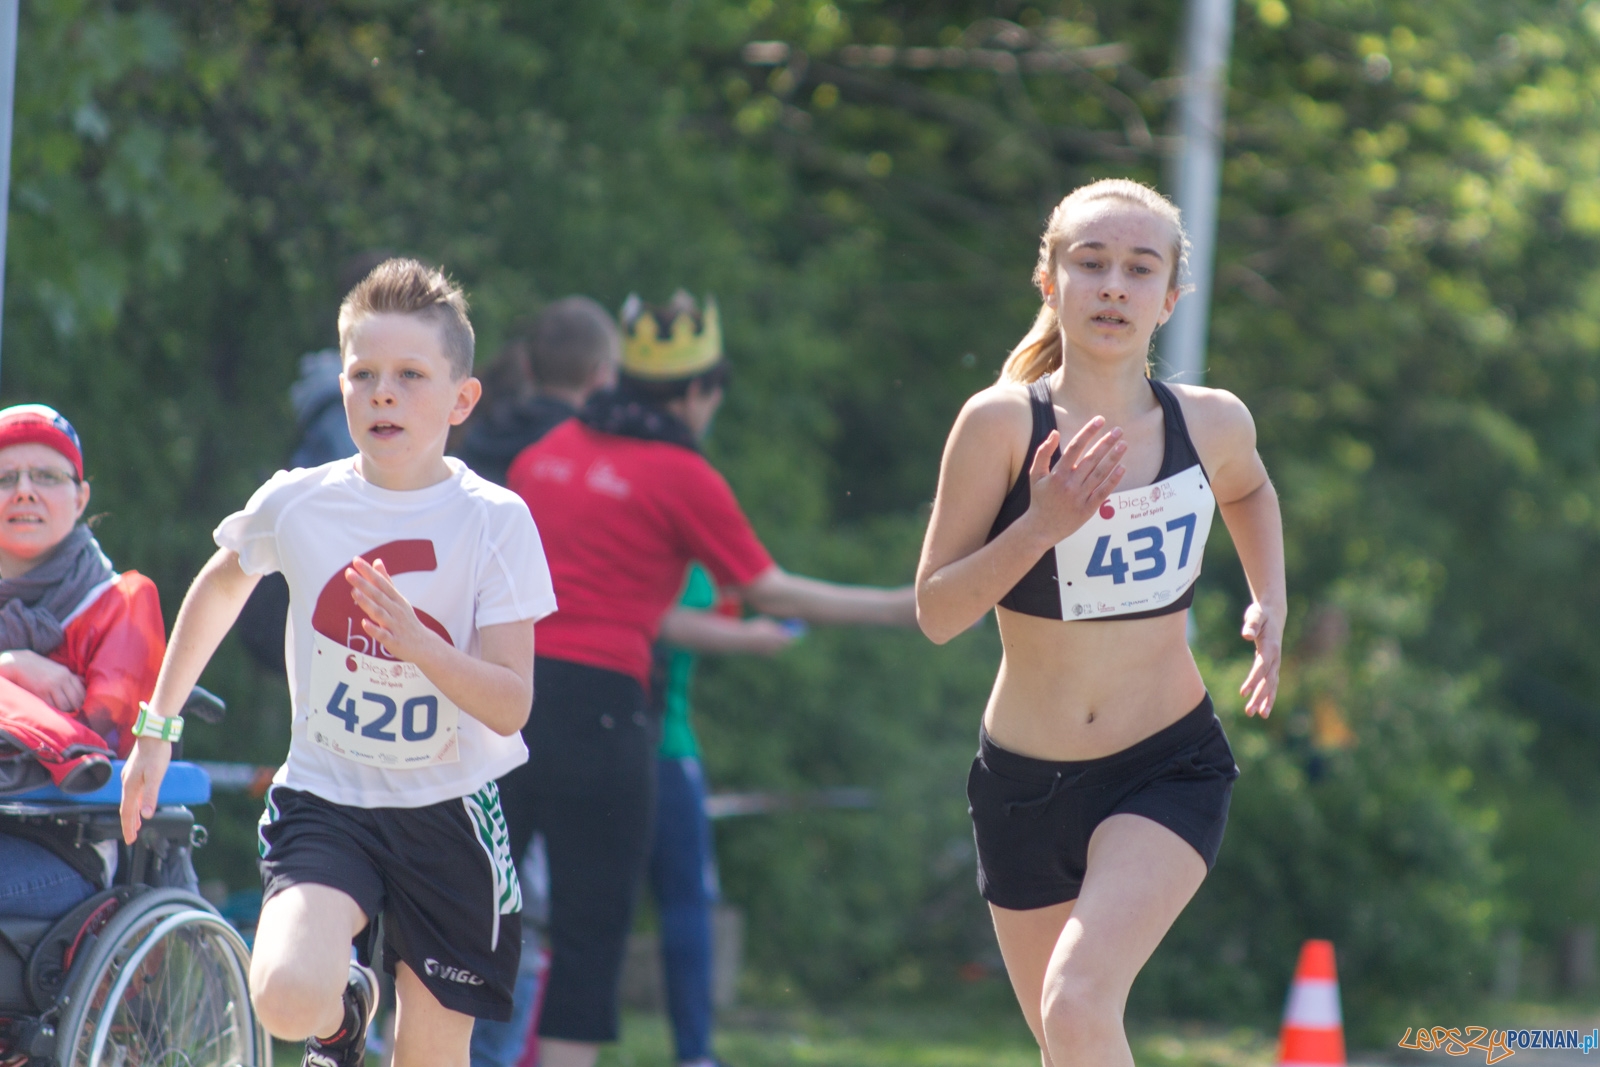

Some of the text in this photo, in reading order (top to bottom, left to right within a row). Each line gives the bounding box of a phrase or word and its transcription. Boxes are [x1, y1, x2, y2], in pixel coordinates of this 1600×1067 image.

[1118, 495, 1150, 511] bieg
[1149, 506, 1164, 516] Spirit
[1085, 512, 1197, 585] 437
[326, 681, 438, 742] 420
